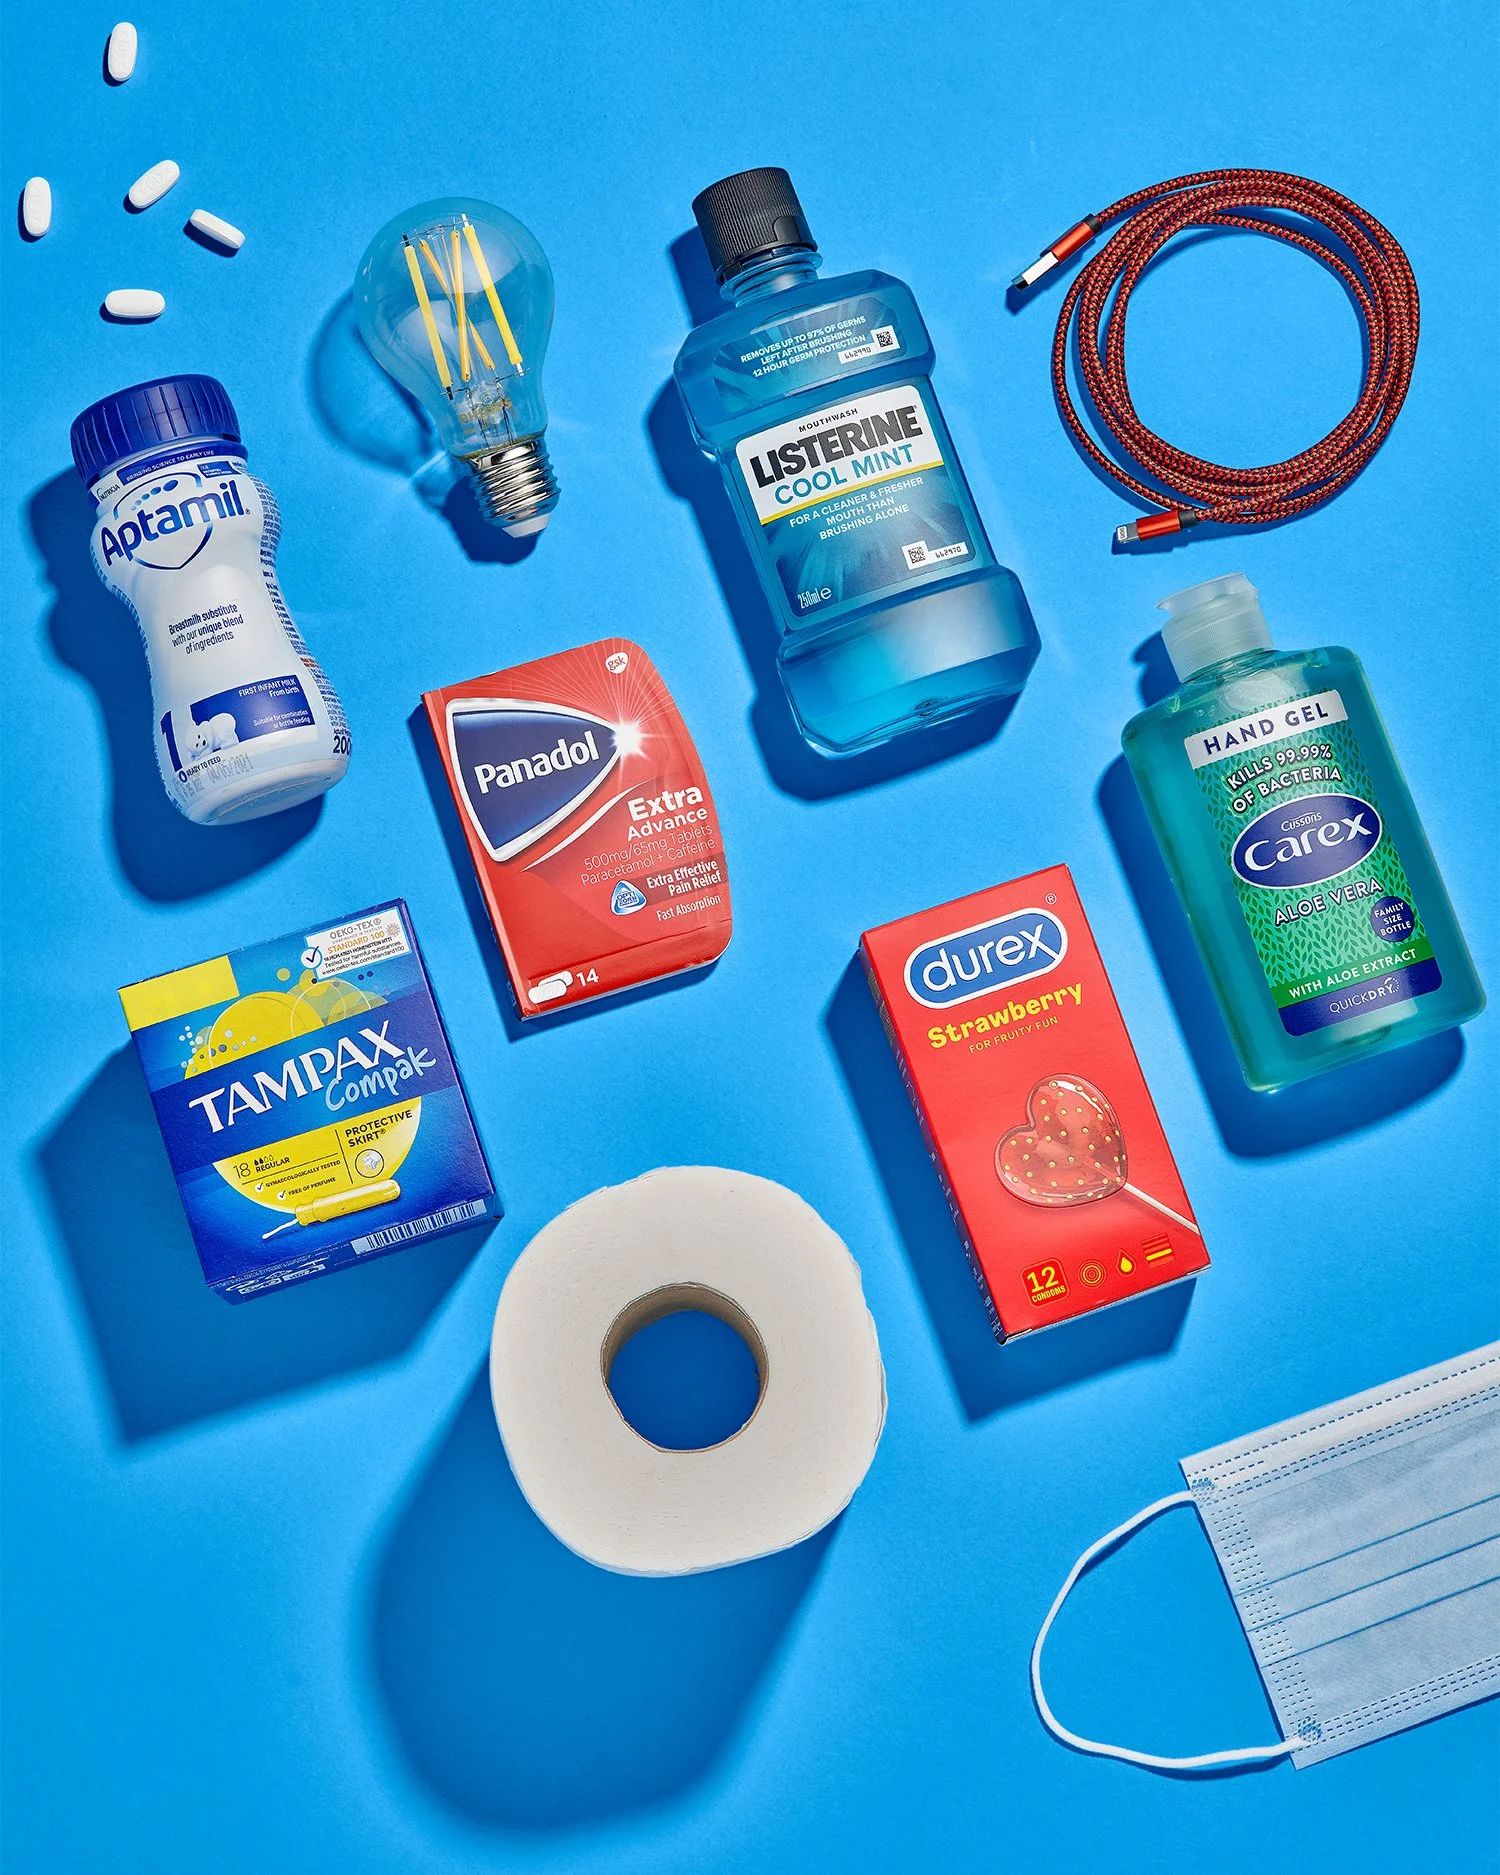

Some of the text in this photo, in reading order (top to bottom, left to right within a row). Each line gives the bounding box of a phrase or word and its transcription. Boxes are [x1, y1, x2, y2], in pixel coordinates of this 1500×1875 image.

[740, 316, 866, 363] REMOVES UP TO 97% OF GERMS
[760, 329, 852, 365] LEFT AFTER BRUSHING
[752, 335, 866, 378] 12 HOUR GERM PROTECTION
[799, 408, 858, 432] MOUTHWASH
[749, 405, 923, 488] LISTERINE
[126, 467, 152, 482] BRINGING
[152, 458, 176, 471] SCIENCE
[176, 454, 185, 462] TO
[186, 451, 203, 460] EARLY
[774, 443, 912, 505] COOL MINT
[98, 484, 120, 501] NUTRICIA
[789, 477, 924, 528] FOR A CLEANER & FRESHER
[819, 503, 910, 540] BRUSHING ALONE
[826, 496, 895, 526] MOUTH THAN
[797, 587, 821, 609] 250ml
[168, 604, 238, 635] Breastmilk substitute
[172, 614, 244, 647] with our unique blend
[185, 631, 234, 654] of ingredients
[607, 655, 626, 671] gsk
[238, 678, 296, 697] FIRST INFANT MILK
[269, 686, 299, 697] From birth
[253, 716, 274, 727] Suitable
[1203, 702, 1329, 755] HAND GEL
[160, 711, 183, 772] 1
[186, 756, 221, 776] READY TO FEED
[474, 730, 600, 794] Panadol
[1226, 744, 1332, 790] KILLS 99.99%
[627, 786, 704, 821] Extra
[1232, 765, 1342, 814] OF BACTERIA
[627, 807, 708, 842] Advance
[1281, 811, 1322, 832] Cussons
[584, 824, 713, 871] 500mg/65mg Tablets
[1244, 812, 1373, 871] Carex
[581, 854, 655, 887] Paracetamol
[667, 839, 716, 861] Caffeine
[646, 859, 718, 889] Extra Effective
[668, 871, 722, 896] Pain Relief
[656, 895, 721, 921] Fast Absorption
[1274, 878, 1383, 926] ALOE VERA
[1374, 902, 1405, 918] FAMILY
[1380, 921, 1412, 937] BOTTLE
[1383, 914, 1403, 925] SIZE
[327, 931, 385, 954] STANDARD 100
[922, 923, 1060, 992] durex
[325, 957, 342, 968] Tested
[343, 954, 352, 962] for
[352, 948, 372, 960] harmful
[576, 968, 599, 988] 14
[1289, 948, 1417, 999] WITH ALOE EXTRACT
[1329, 984, 1394, 1014] QUICKDRY
[927, 982, 1082, 1049] Strawberry
[969, 1016, 1058, 1053] FOR FRUITY FUN
[188, 1020, 406, 1133] TAMPAX
[325, 1047, 438, 1111] Compak
[345, 1110, 412, 1138] PROTECTIVE
[233, 1162, 251, 1179] 18
[255, 1156, 291, 1173] REGULAR
[266, 1159, 341, 1188] GYNAECOLOGICALLY TESTED
[288, 1177, 336, 1196] FREE OF PERFUME
[1026, 1265, 1059, 1293] 12
[1031, 1285, 1066, 1303] CONDOMS
